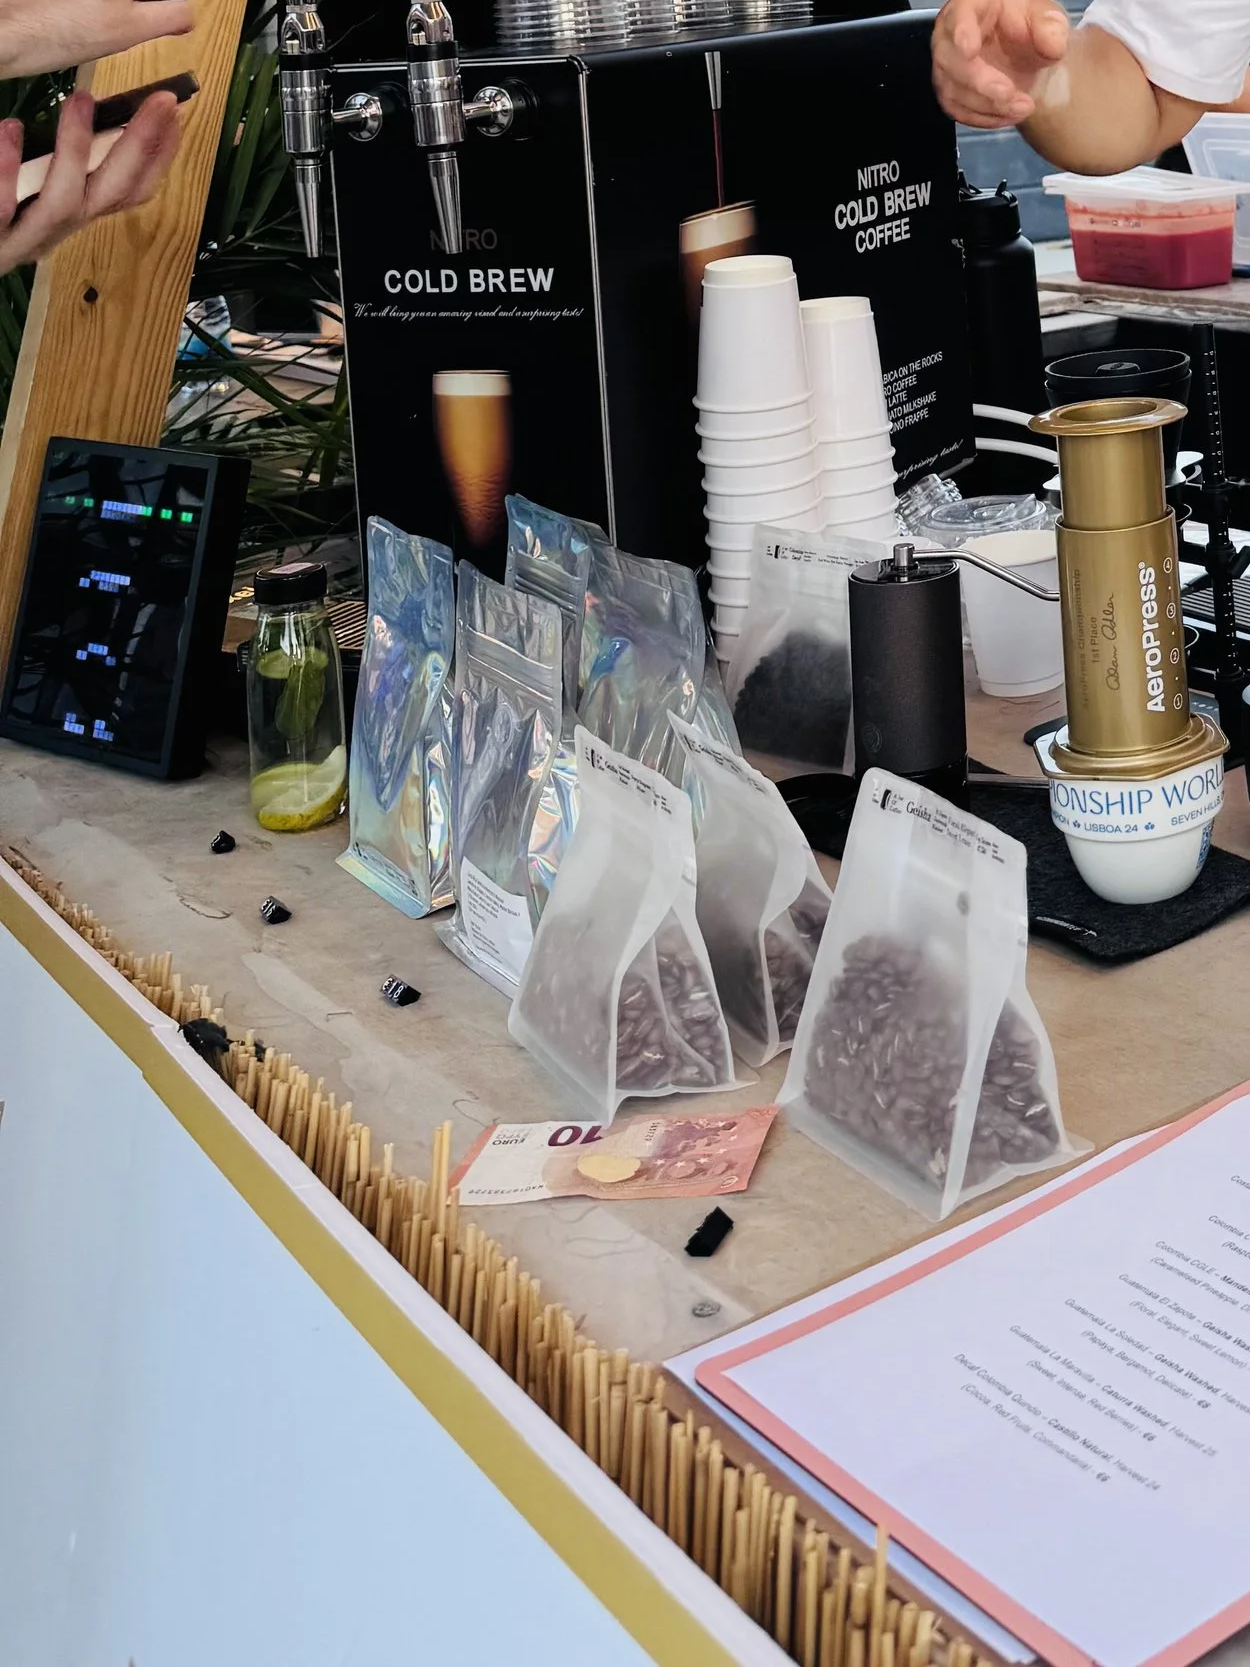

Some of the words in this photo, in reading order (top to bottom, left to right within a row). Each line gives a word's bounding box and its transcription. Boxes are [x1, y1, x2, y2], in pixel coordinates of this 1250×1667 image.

[857, 160, 900, 191] NITRO
[834, 195, 878, 230] COLD
[884, 181, 932, 216] BREW
[855, 217, 911, 253] COFFEE
[384, 269, 458, 294] COLD
[469, 268, 555, 293] BREW
[898, 366, 908, 378] ON
[908, 360, 921, 374] THE
[922, 351, 943, 367] ROCKS
[892, 374, 918, 394] COFFEE
[888, 391, 908, 408] LATTE
[903, 391, 937, 415] MILKSHAKE
[905, 407, 929, 428] FRAPPE
[1089, 616, 1099, 646] Place
[1139, 567, 1166, 712] AeroPress
[1084, 822, 1122, 833] LISBOA
[1124, 824, 1138, 833] 24
[1171, 809, 1203, 826] SEVEN
[381, 976, 405, 999] €18
[492, 1137, 525, 1146] EURO
[548, 1125, 603, 1147] 10
[1208, 1215, 1244, 1237] Colombia
[1155, 1240, 1191, 1262] Colombia
[1190, 1259, 1217, 1275] CGLE
[1119, 1273, 1160, 1300] Guatemala
[1167, 1302, 1196, 1320] Zapote
[1202, 1321, 1233, 1340] Geisha
[1065, 1298, 1106, 1326] Guatemala
[1104, 1322, 1117, 1333] La
[1115, 1330, 1150, 1352] Soledad
[1154, 1353, 1185, 1373] Geisha
[1189, 1333, 1217, 1351] Sweet
[954, 1353, 981, 1371] Decaf
[977, 1368, 1013, 1396] Colombia
[1010, 1324, 1050, 1354] Guatemala
[1049, 1351, 1061, 1361] La
[1101, 1384, 1134, 1407] Caturra
[991, 1403, 1012, 1418] Red
[1087, 1397, 1108, 1412] Red
